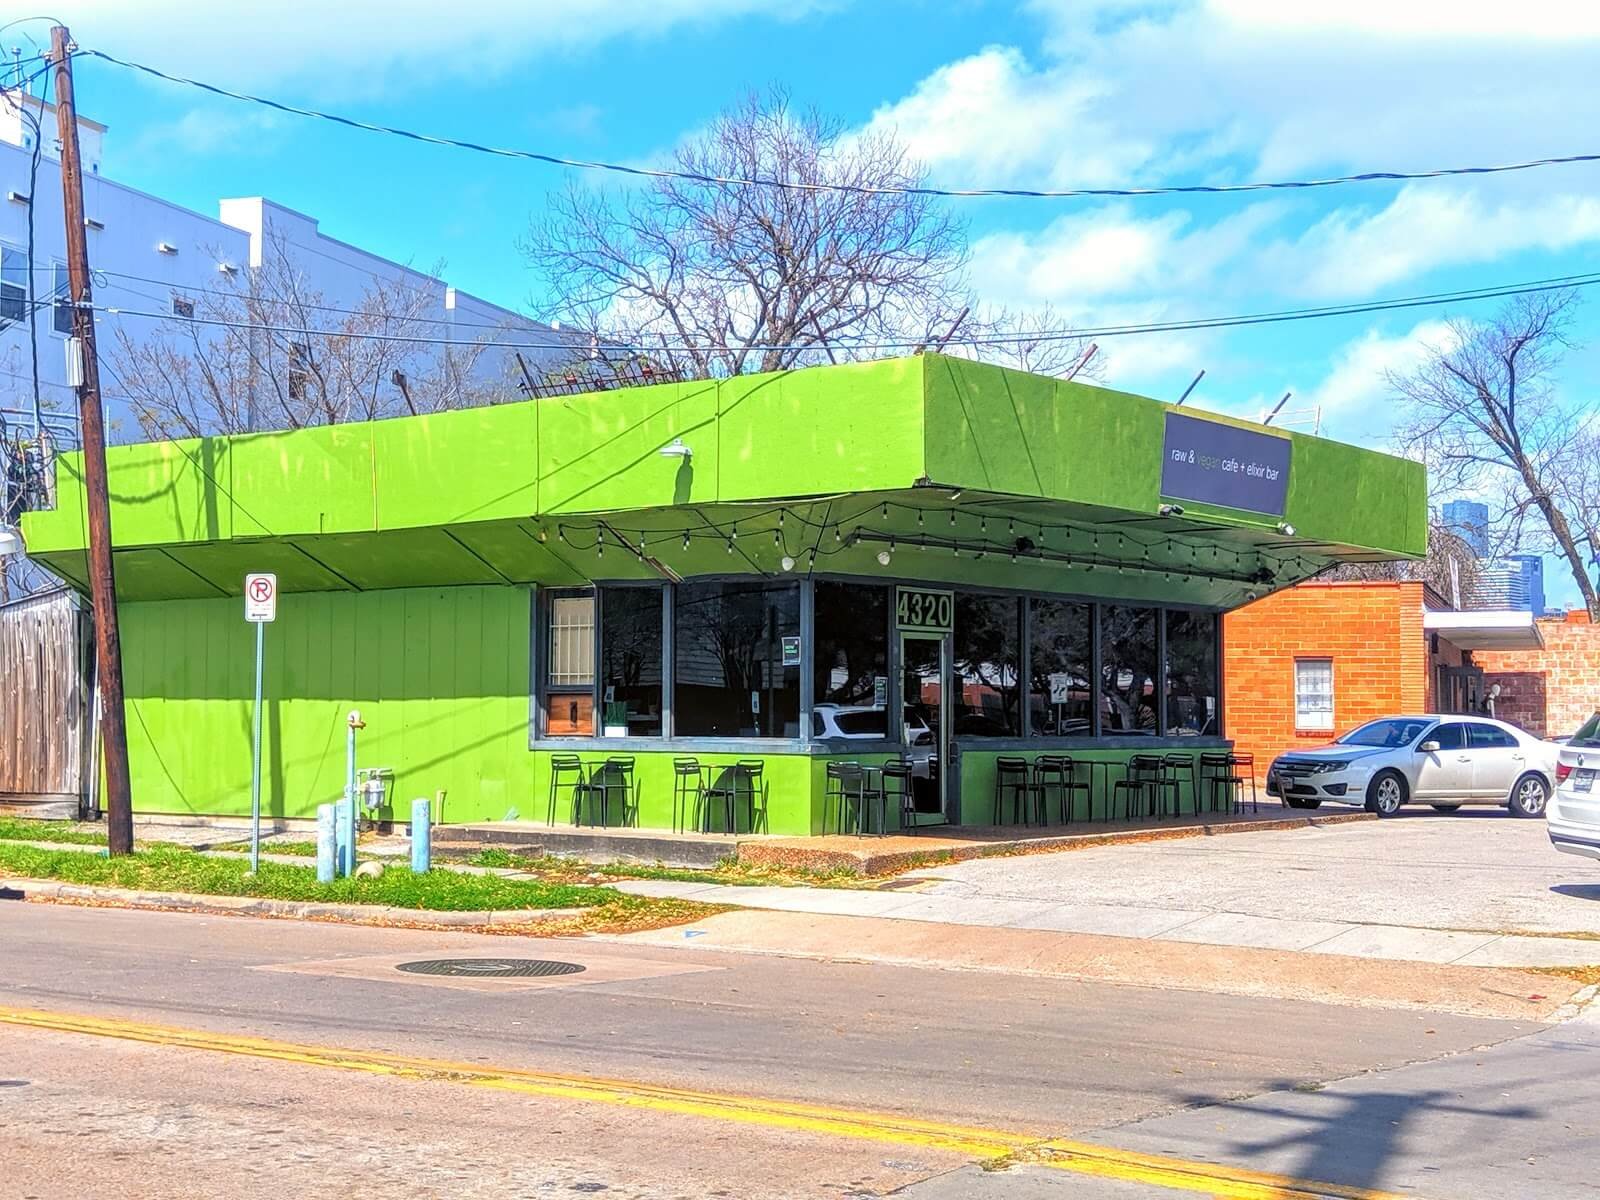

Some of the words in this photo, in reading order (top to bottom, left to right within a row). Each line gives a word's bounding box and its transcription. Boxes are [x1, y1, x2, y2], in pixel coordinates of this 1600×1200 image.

[1171, 449, 1187, 462] raw
[1188, 449, 1195, 464] &
[1221, 458, 1239, 473] cafe
[1246, 462, 1265, 478] elixir
[1266, 465, 1279, 480] bar
[897, 592, 950, 627] 4320
